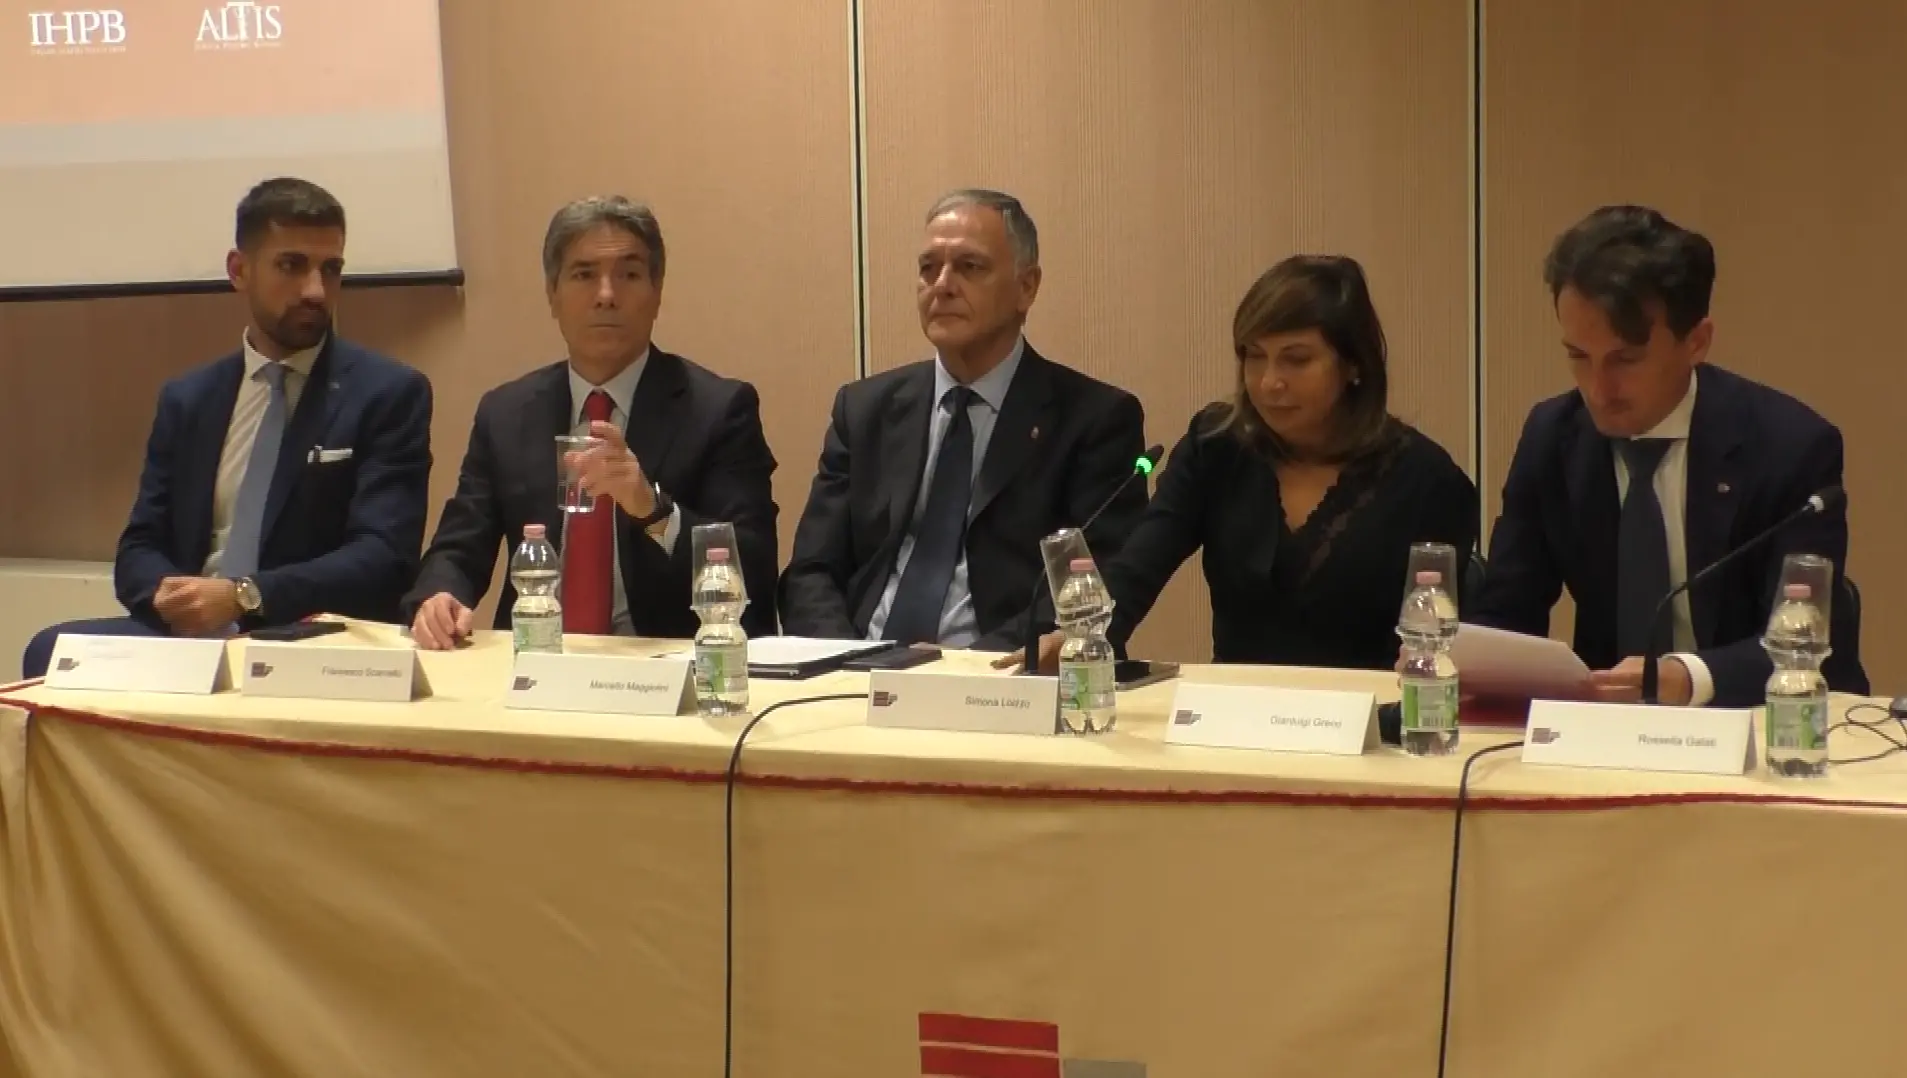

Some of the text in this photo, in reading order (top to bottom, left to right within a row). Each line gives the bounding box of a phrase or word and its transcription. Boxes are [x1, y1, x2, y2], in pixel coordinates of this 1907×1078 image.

[28, 9, 126, 46] IHPB
[195, 1, 282, 41] ALTIS
[965, 696, 999, 707] Simona
